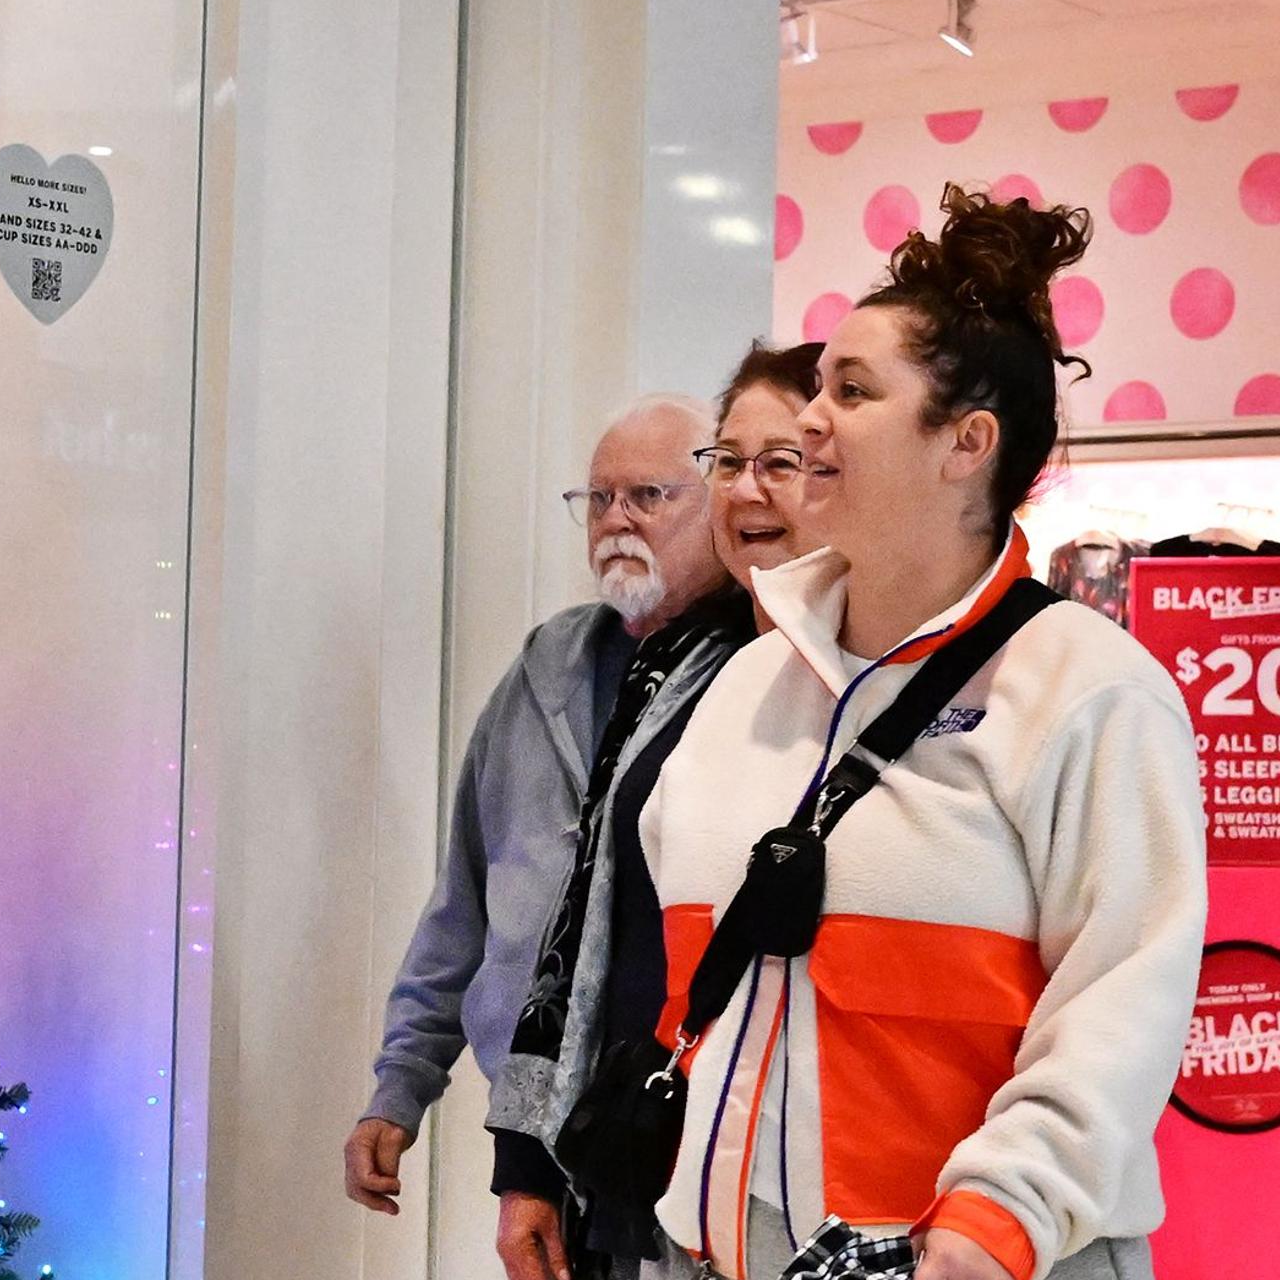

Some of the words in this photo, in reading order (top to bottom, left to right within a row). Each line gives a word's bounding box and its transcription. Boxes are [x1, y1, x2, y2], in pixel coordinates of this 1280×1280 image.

[10, 173, 36, 187] HELLO
[37, 178, 60, 191] MORE
[28, 196, 69, 214] XS-XXL
[26, 216, 56, 232] SIZES
[60, 222, 92, 238] 32-42
[95, 228, 103, 240] &
[21, 233, 52, 248] SIZES
[55, 238, 98, 255] AA-DDD
[1153, 587, 1244, 609] BLACK
[1214, 734, 1256, 753] ALL
